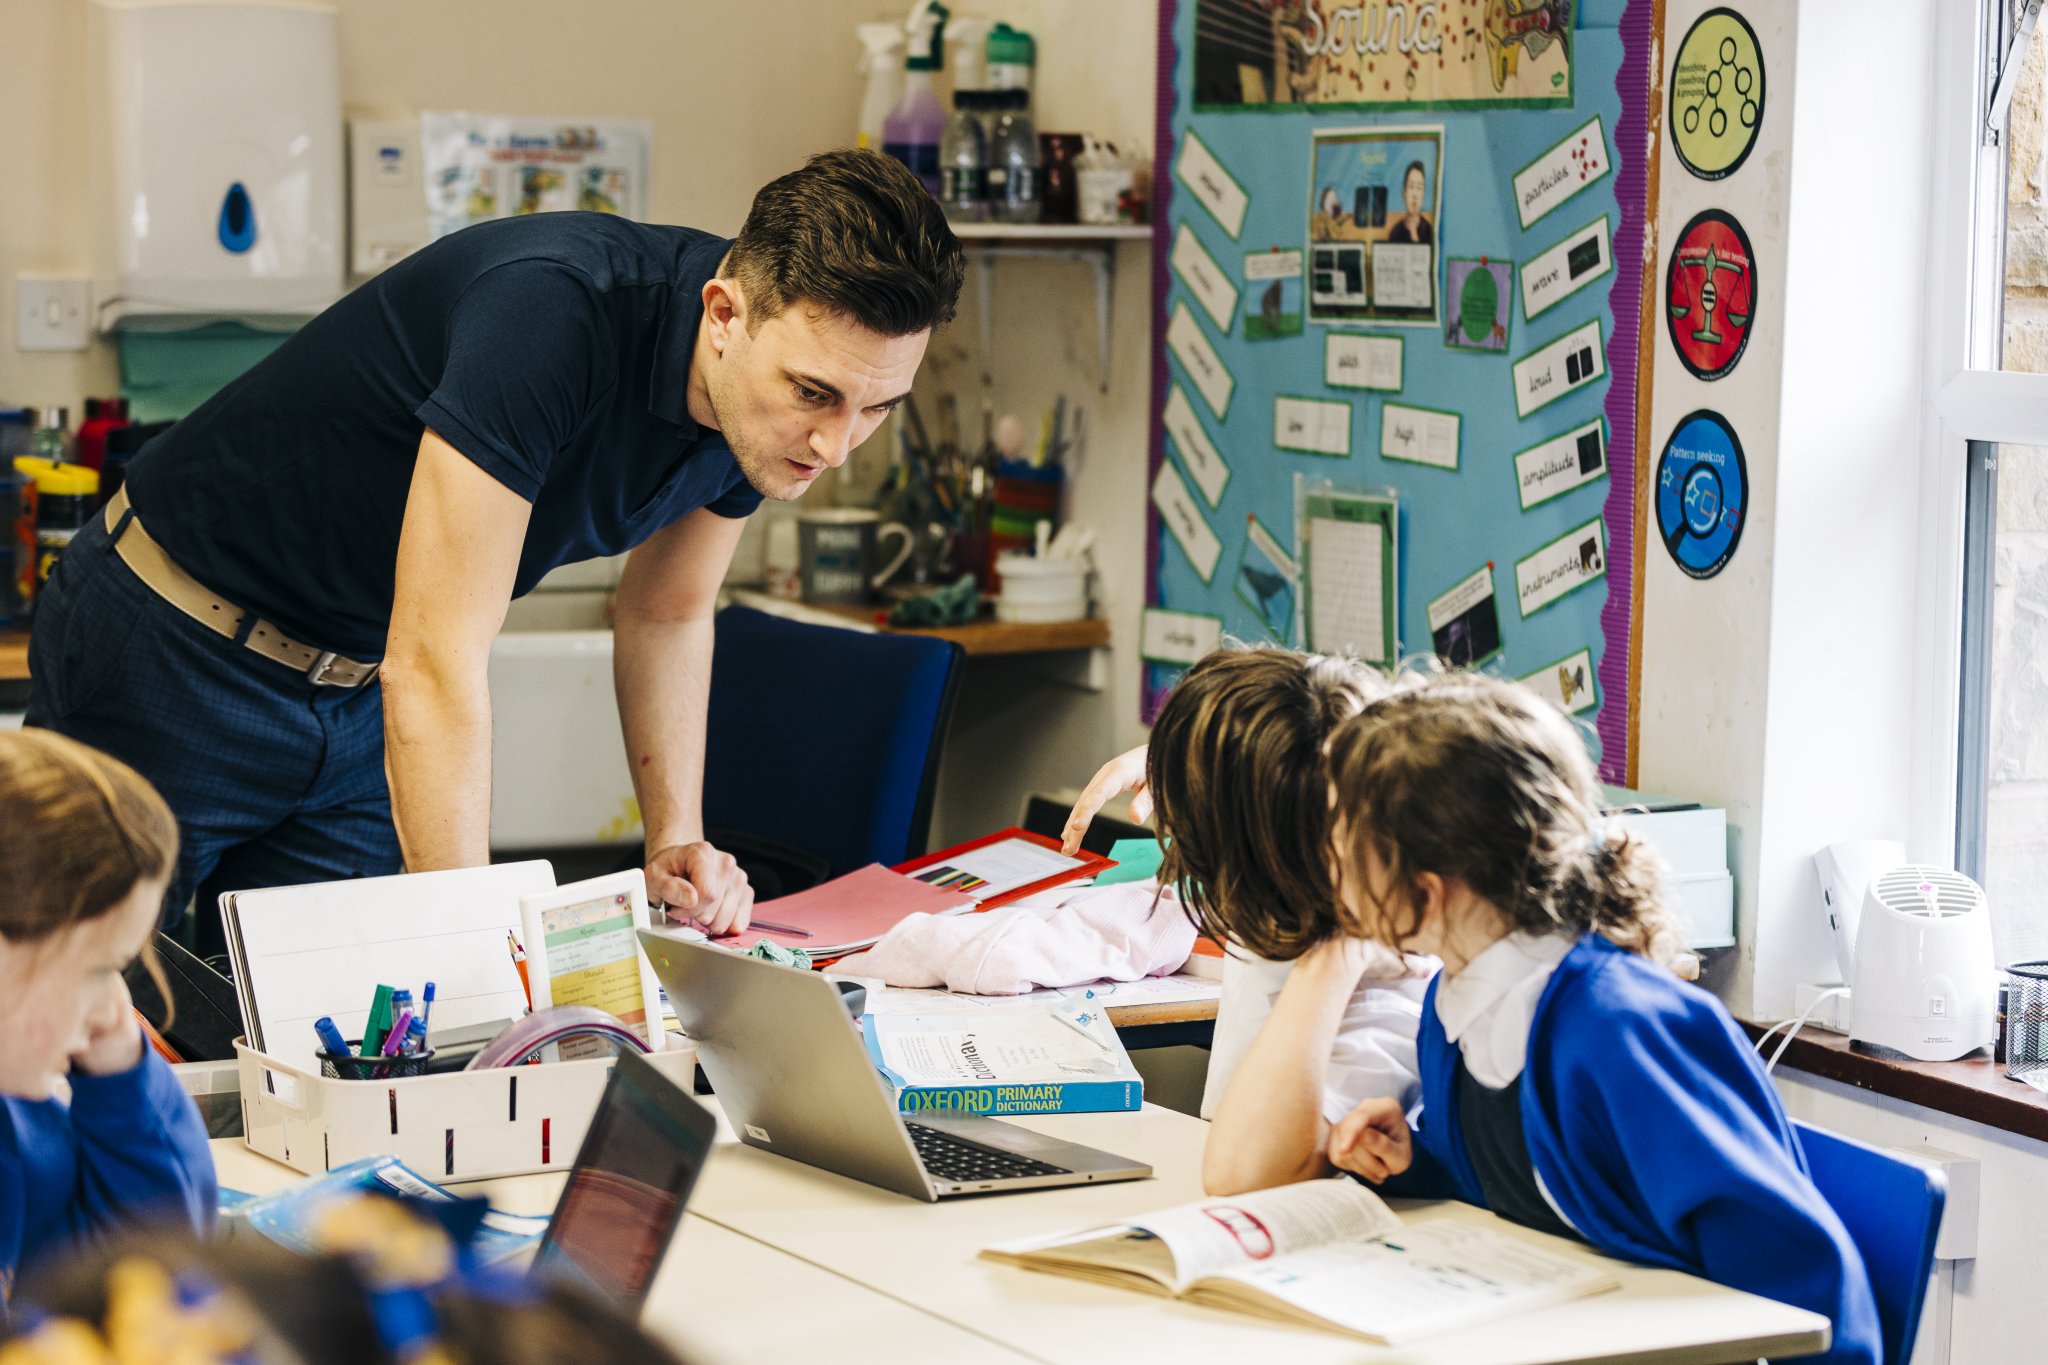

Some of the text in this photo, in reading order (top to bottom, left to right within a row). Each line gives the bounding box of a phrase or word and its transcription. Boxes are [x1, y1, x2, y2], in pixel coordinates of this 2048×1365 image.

[1524, 165, 1569, 209] particles
[1531, 269, 1559, 294] wave
[1529, 366, 1552, 393] loud
[1670, 444, 1725, 467] Pattern seeking
[1523, 452, 1575, 487] amplitude
[1522, 555, 1581, 598] instruments
[904, 1086, 1063, 1112] OXFORD PRIMARY
[996, 1100, 1063, 1112] DICTIONARY
